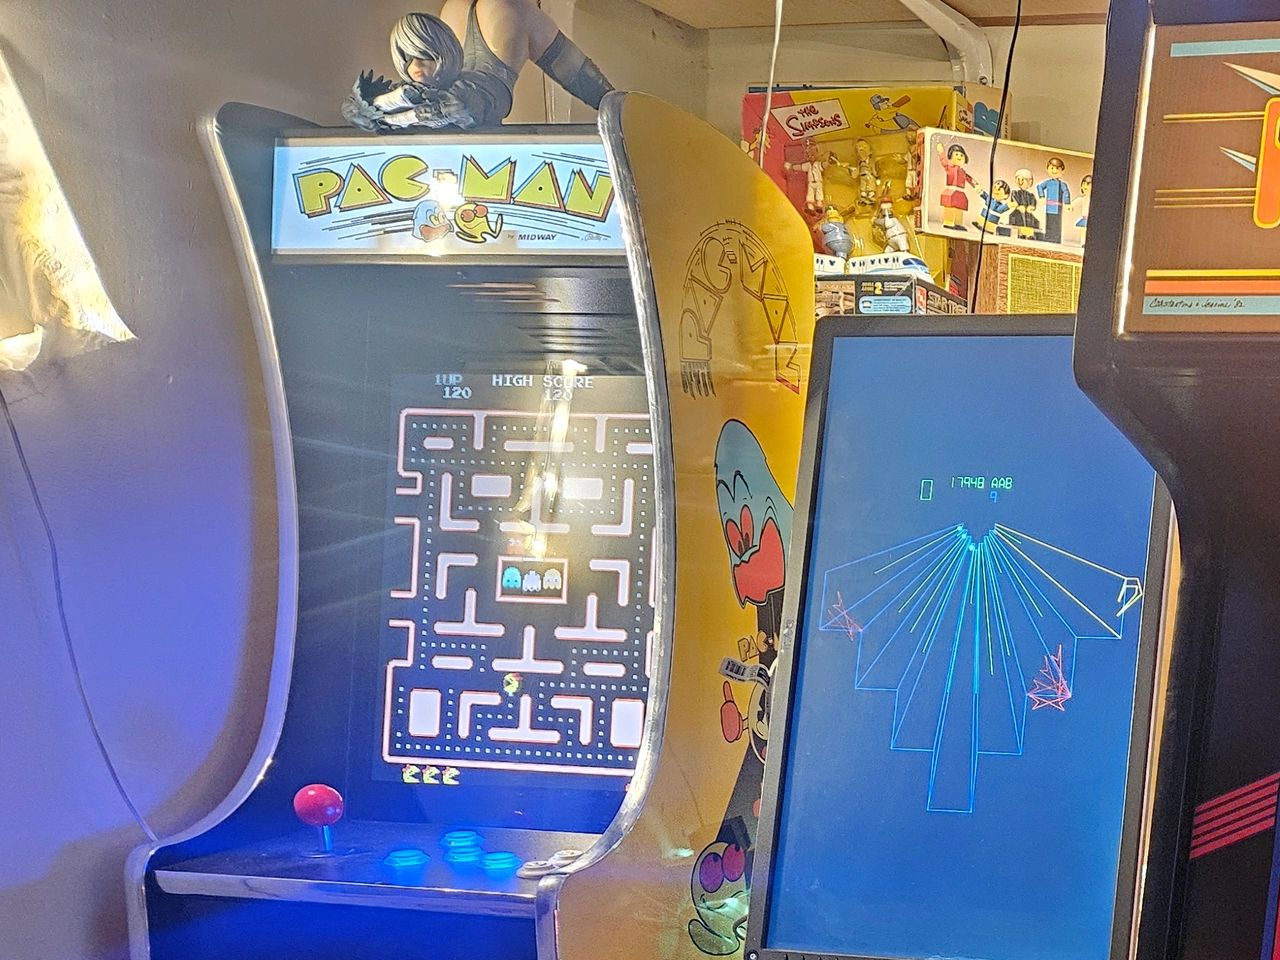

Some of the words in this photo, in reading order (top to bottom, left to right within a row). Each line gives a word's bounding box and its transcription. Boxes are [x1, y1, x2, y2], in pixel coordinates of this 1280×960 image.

[293, 154, 615, 222] PAC-MAN
[518, 233, 558, 241] MIDWAY
[434, 373, 464, 386] 1UP
[492, 374, 533, 387] HIGH
[442, 386, 472, 399] 120
[545, 388, 573, 401] 120
[951, 476, 985, 489] 17948
